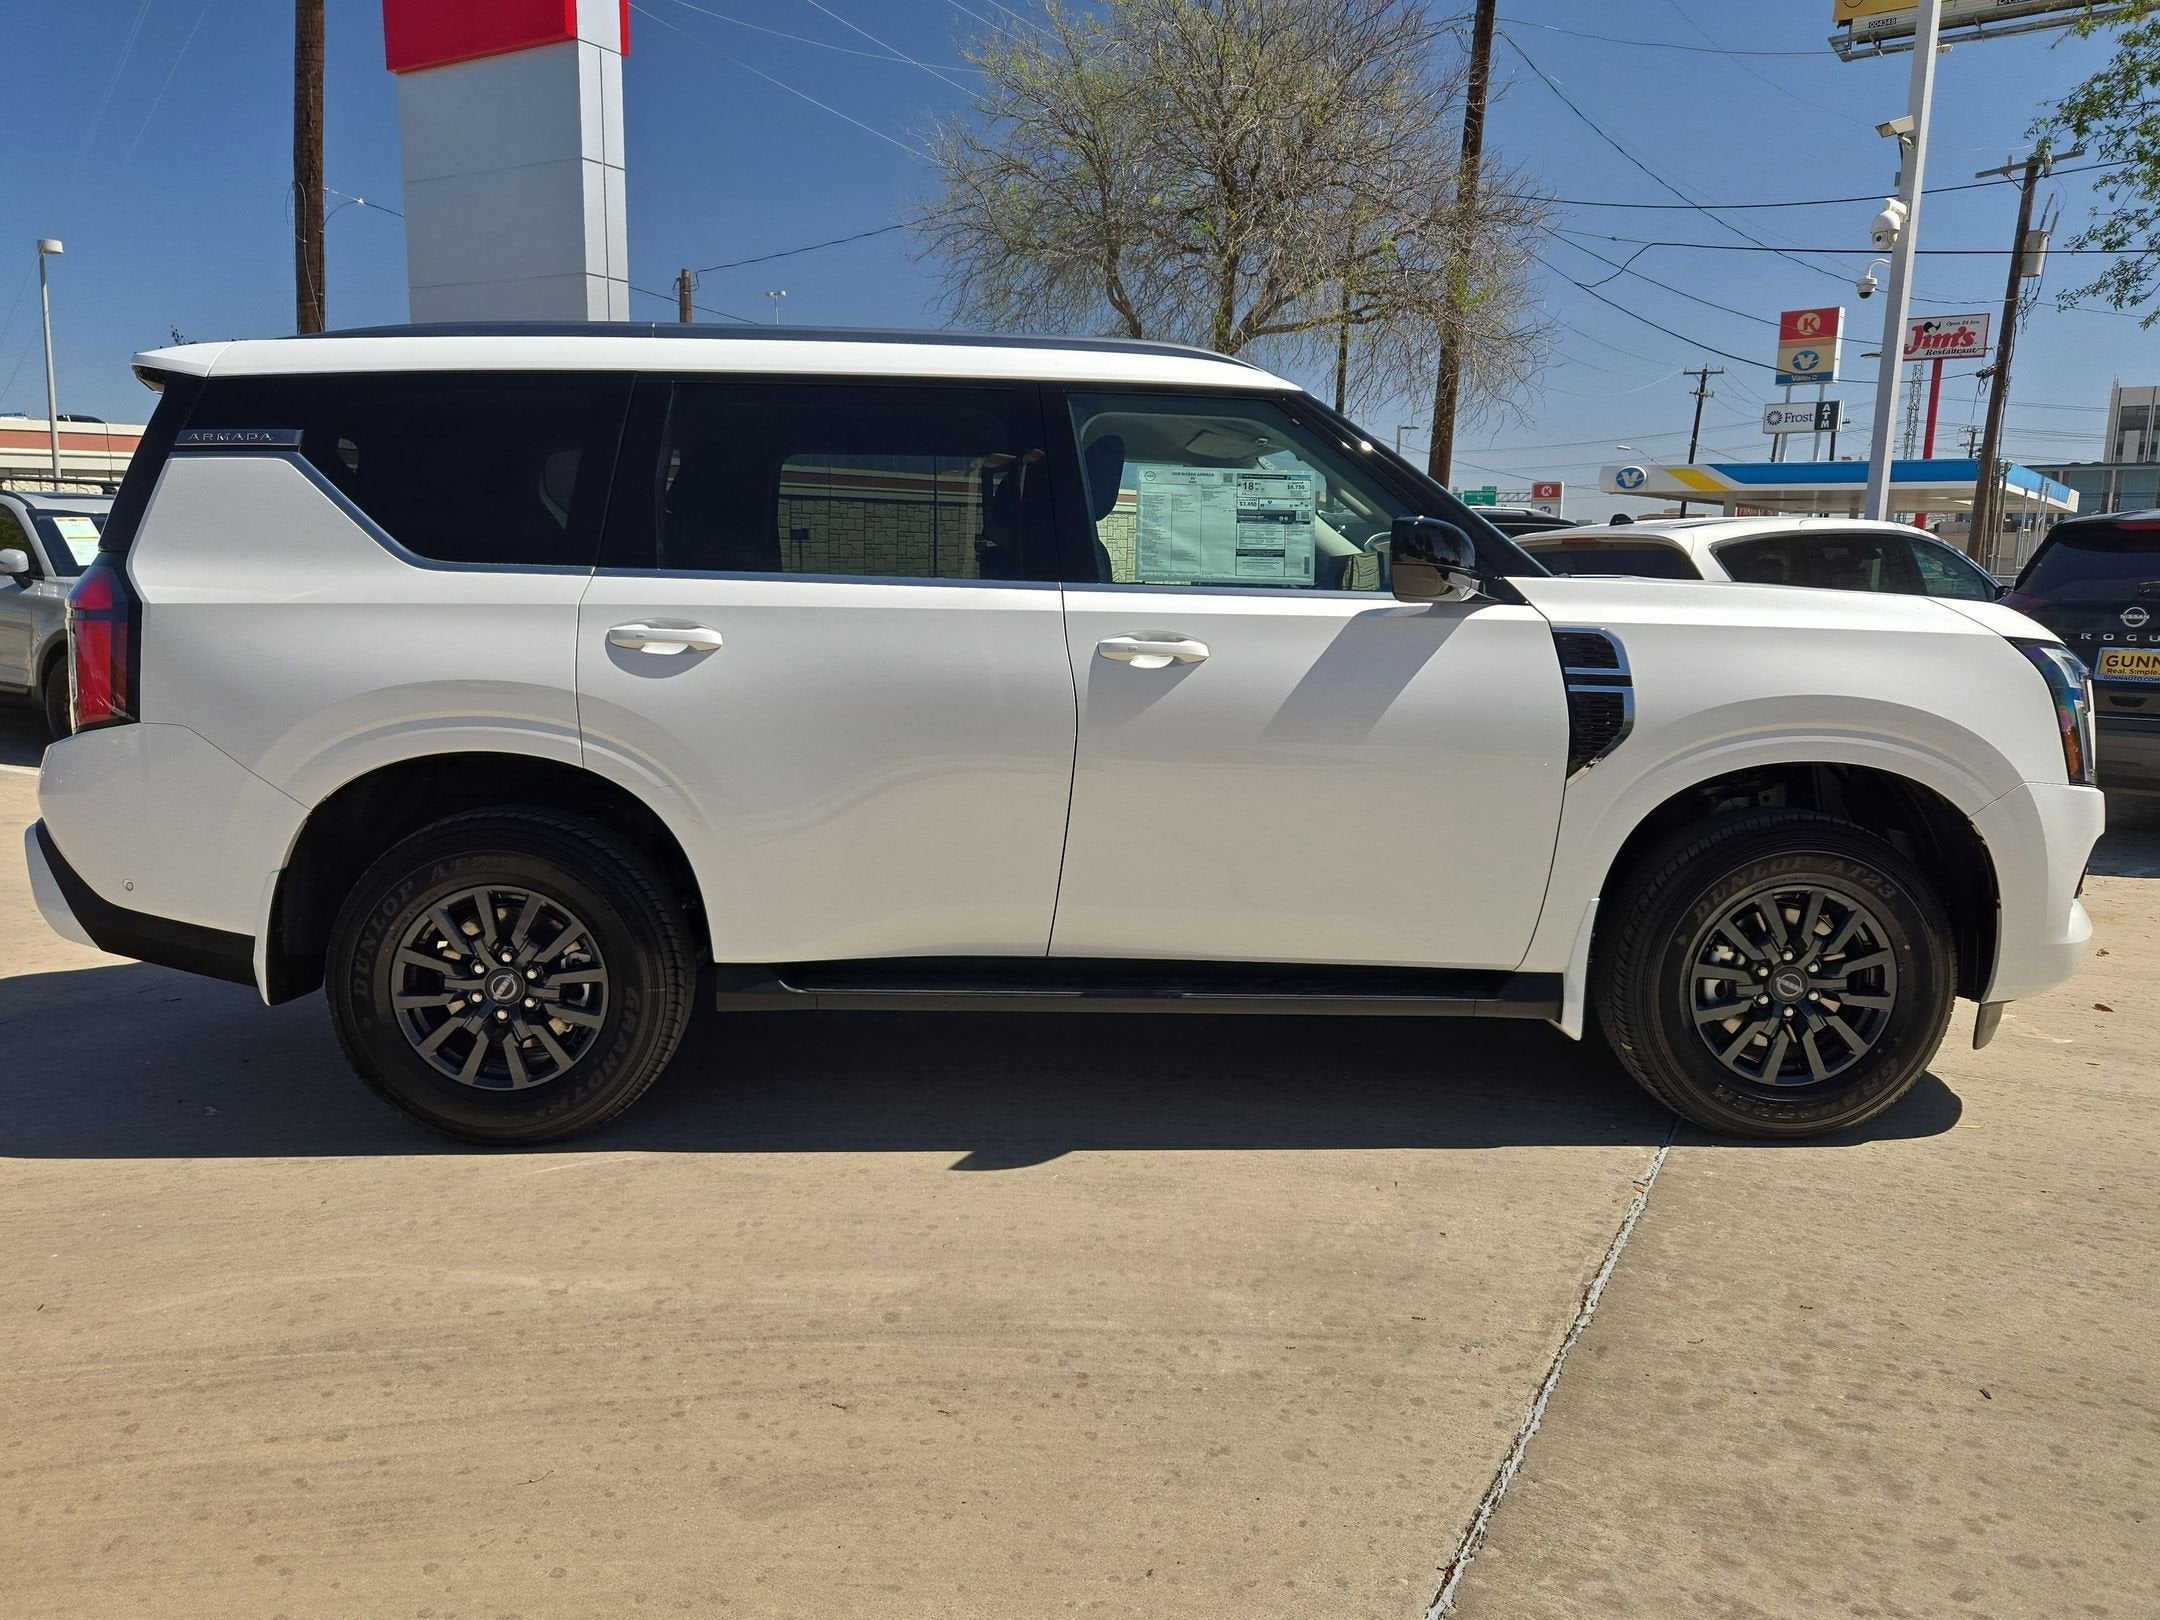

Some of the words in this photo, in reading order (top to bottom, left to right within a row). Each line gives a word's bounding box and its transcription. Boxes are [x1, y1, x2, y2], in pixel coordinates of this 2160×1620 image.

[1904, 325, 1977, 355] Jim's
[1925, 347, 1977, 356] Restaurant
[1784, 412, 1814, 423] Frost
[1821, 403, 1831, 429] ATM
[187, 432, 274, 441] ARMADA
[1243, 482, 1254, 491] 18
[1693, 857, 1813, 918] DUNLOP
[1824, 861, 1897, 900] AT23
[353, 880, 415, 998] DUNLOP
